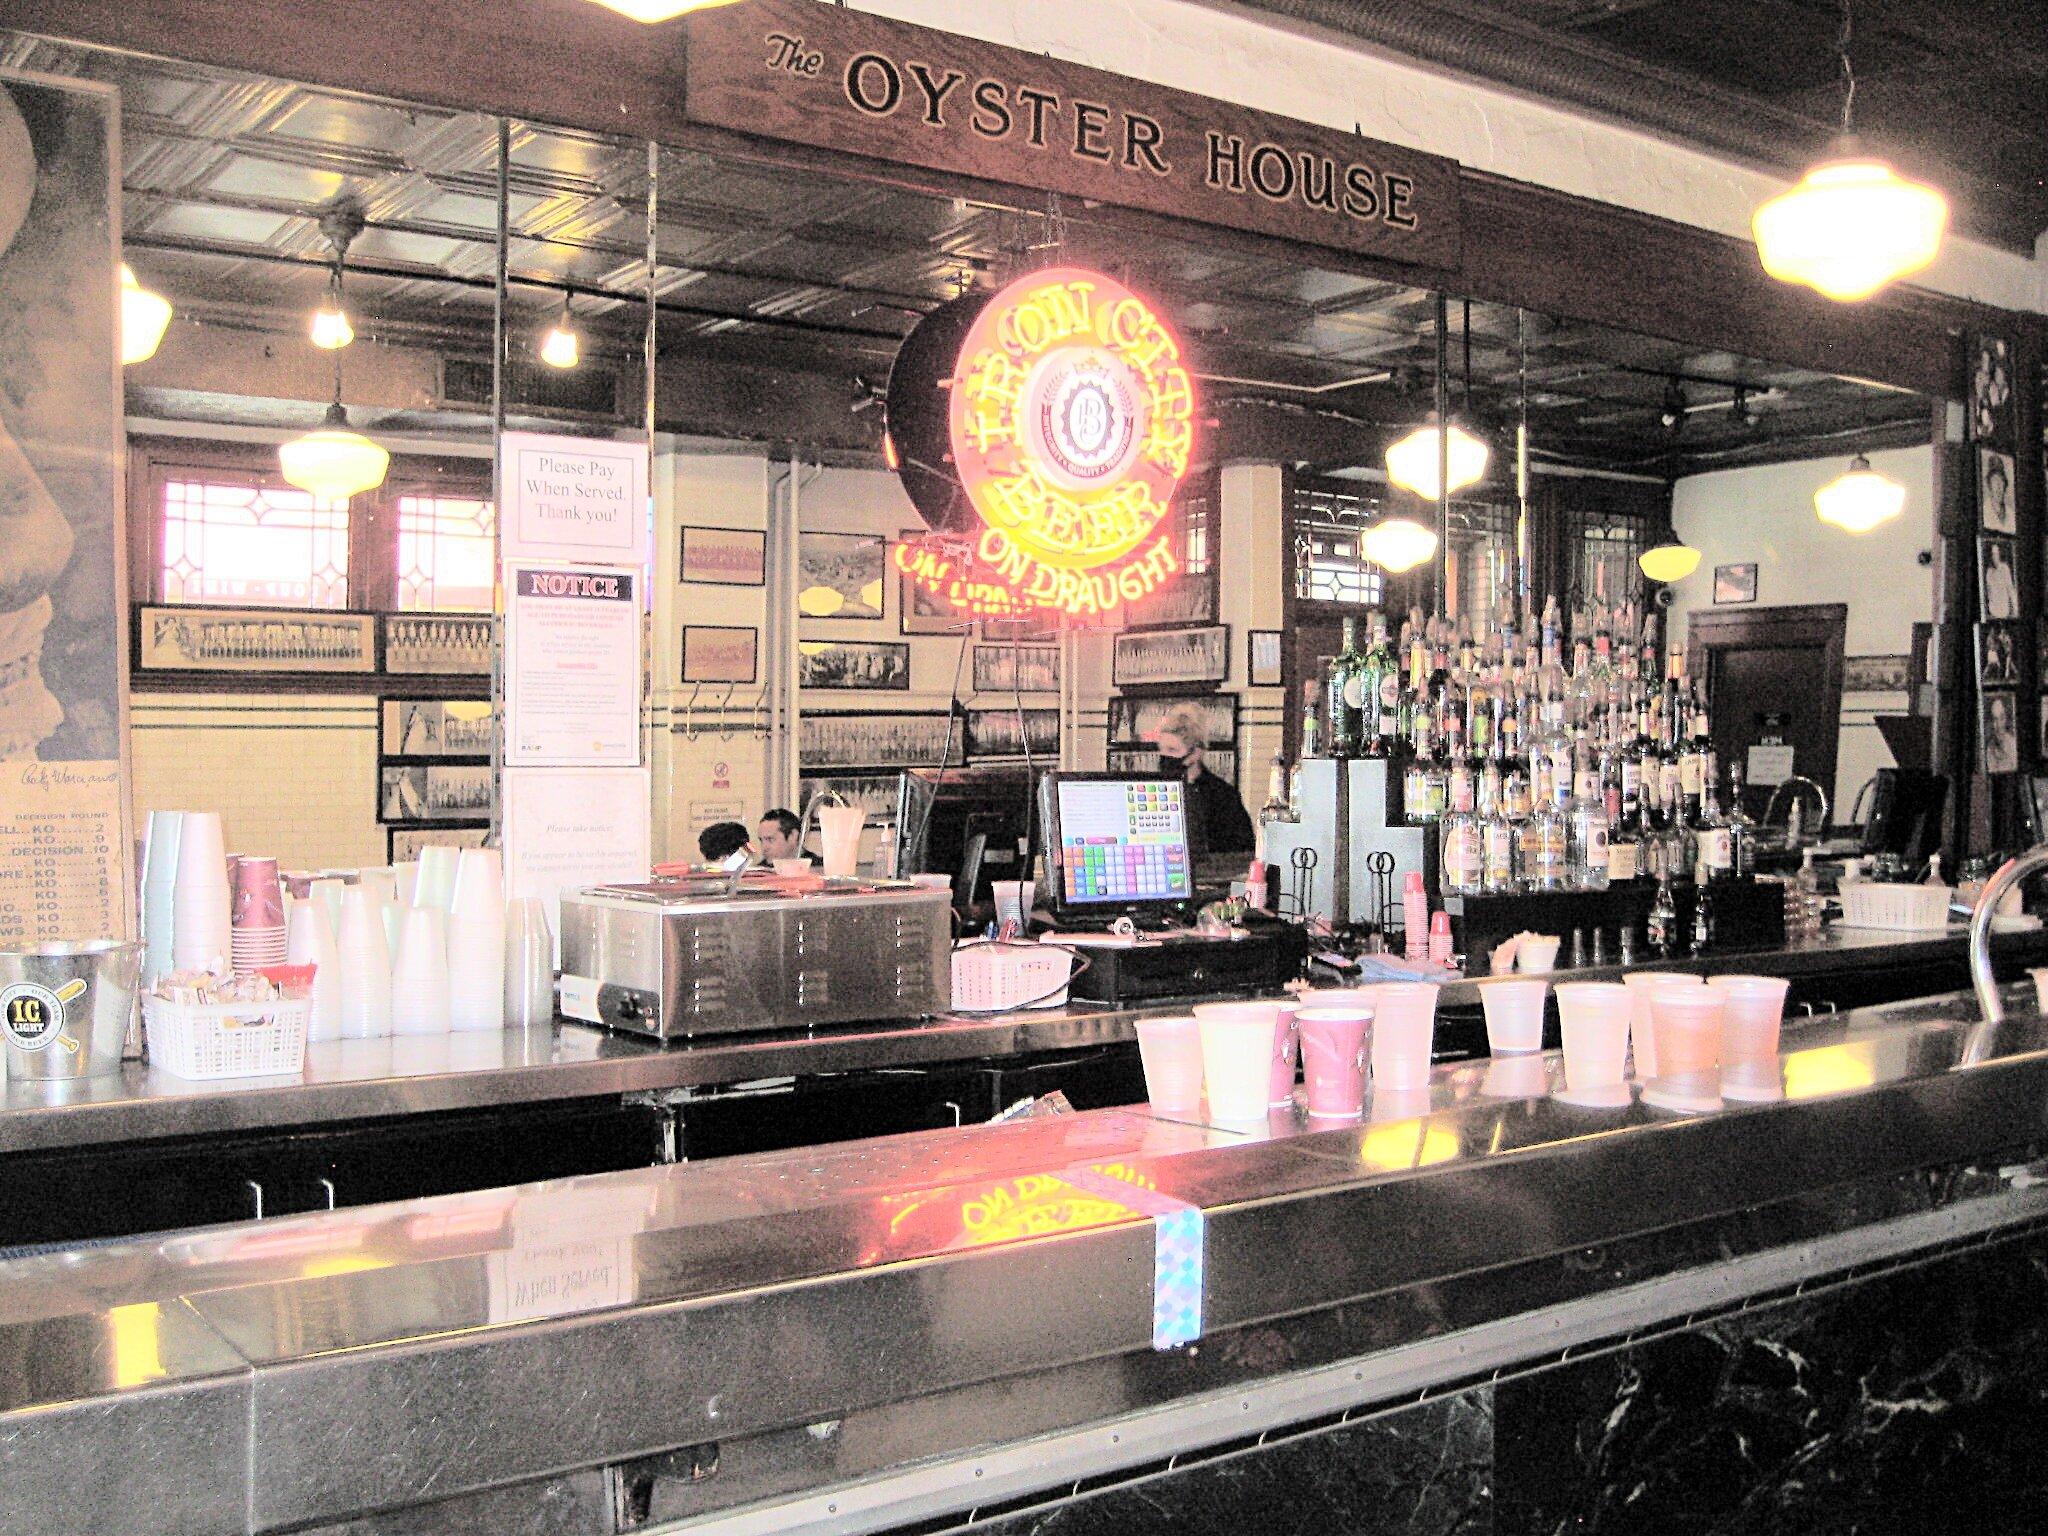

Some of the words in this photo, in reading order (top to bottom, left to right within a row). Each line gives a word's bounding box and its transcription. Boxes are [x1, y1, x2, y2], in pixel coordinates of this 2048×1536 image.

[764, 32, 824, 76] The
[843, 49, 1171, 176] OYSTER
[1205, 128, 1418, 231] HOUSE
[538, 456, 585, 476] Please
[589, 460, 616, 480] Pay
[526, 478, 570, 497] When
[575, 482, 627, 501] Served.
[990, 457, 1168, 552] BEER
[536, 502, 583, 521] Thank
[586, 508, 618, 525] you!
[978, 528, 1031, 586] ON
[1024, 536, 1179, 614] DRAUGHT
[531, 573, 619, 598] NOTICE
[15, 813, 66, 821] DECISION
[70, 811, 110, 819] ROUND
[32, 824, 56, 834] KO
[33, 835, 56, 845] KO
[11, 846, 84, 857] DECISION
[34, 857, 56, 867] KO
[34, 868, 56, 878] KO
[35, 879, 57, 889] KO
[35, 890, 57, 900] KO
[36, 901, 58, 911] KO
[37, 913, 60, 923] KO
[37, 925, 60, 935] KO
[12, 1022, 45, 1032] LIGHT
